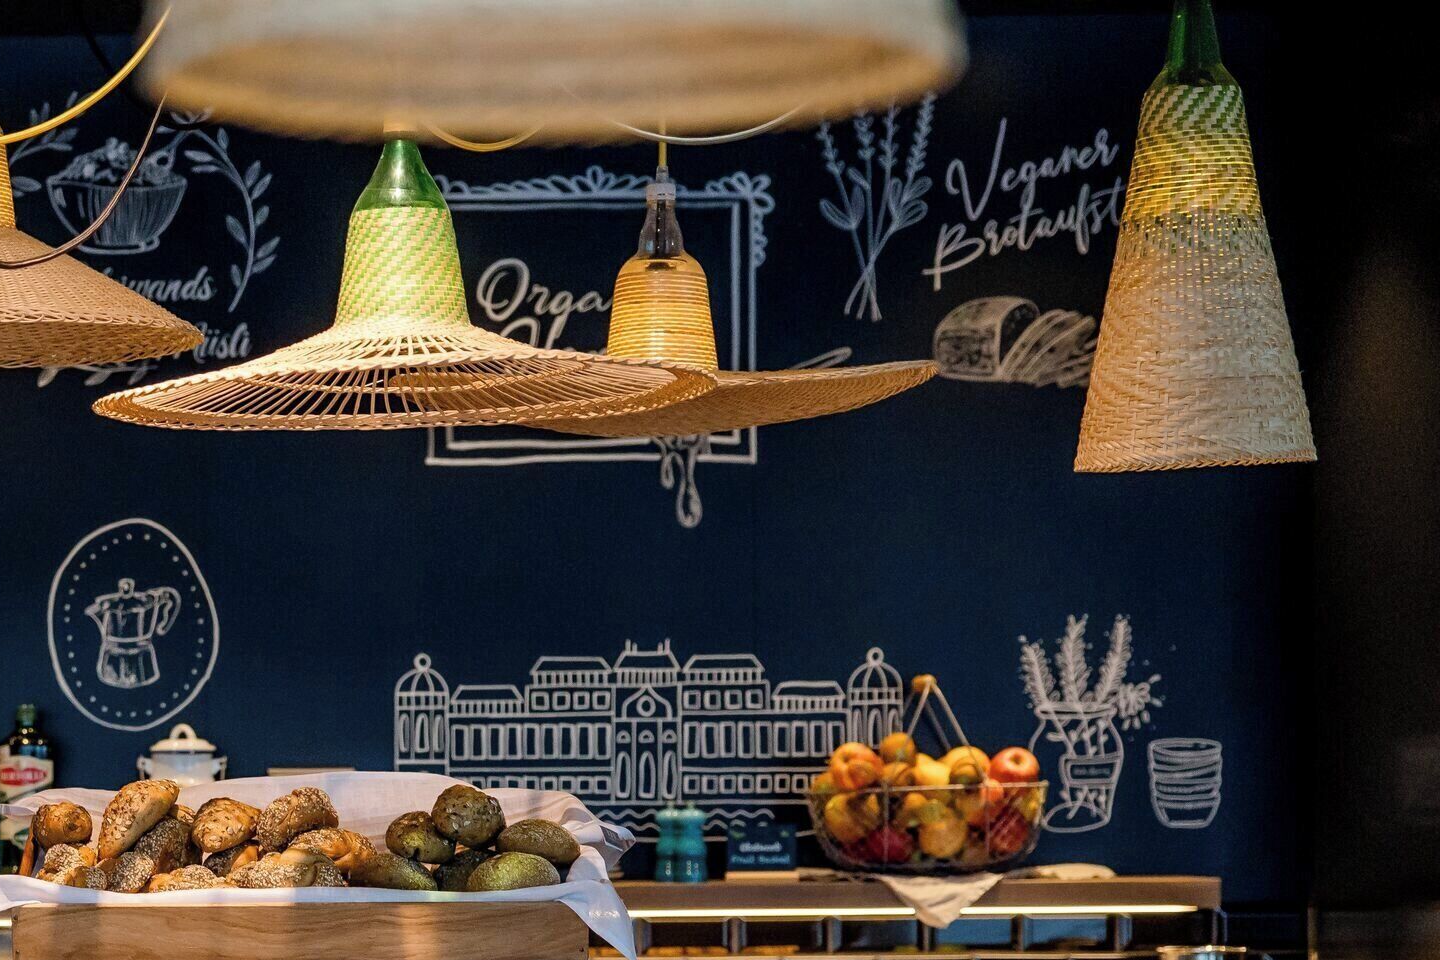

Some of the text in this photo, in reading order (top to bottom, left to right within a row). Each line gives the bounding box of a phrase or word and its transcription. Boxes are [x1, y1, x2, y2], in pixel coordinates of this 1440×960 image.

[945, 117, 1120, 221] Veganer
[921, 176, 1128, 292] Brotaufst
[476, 258, 613, 342] Orga
